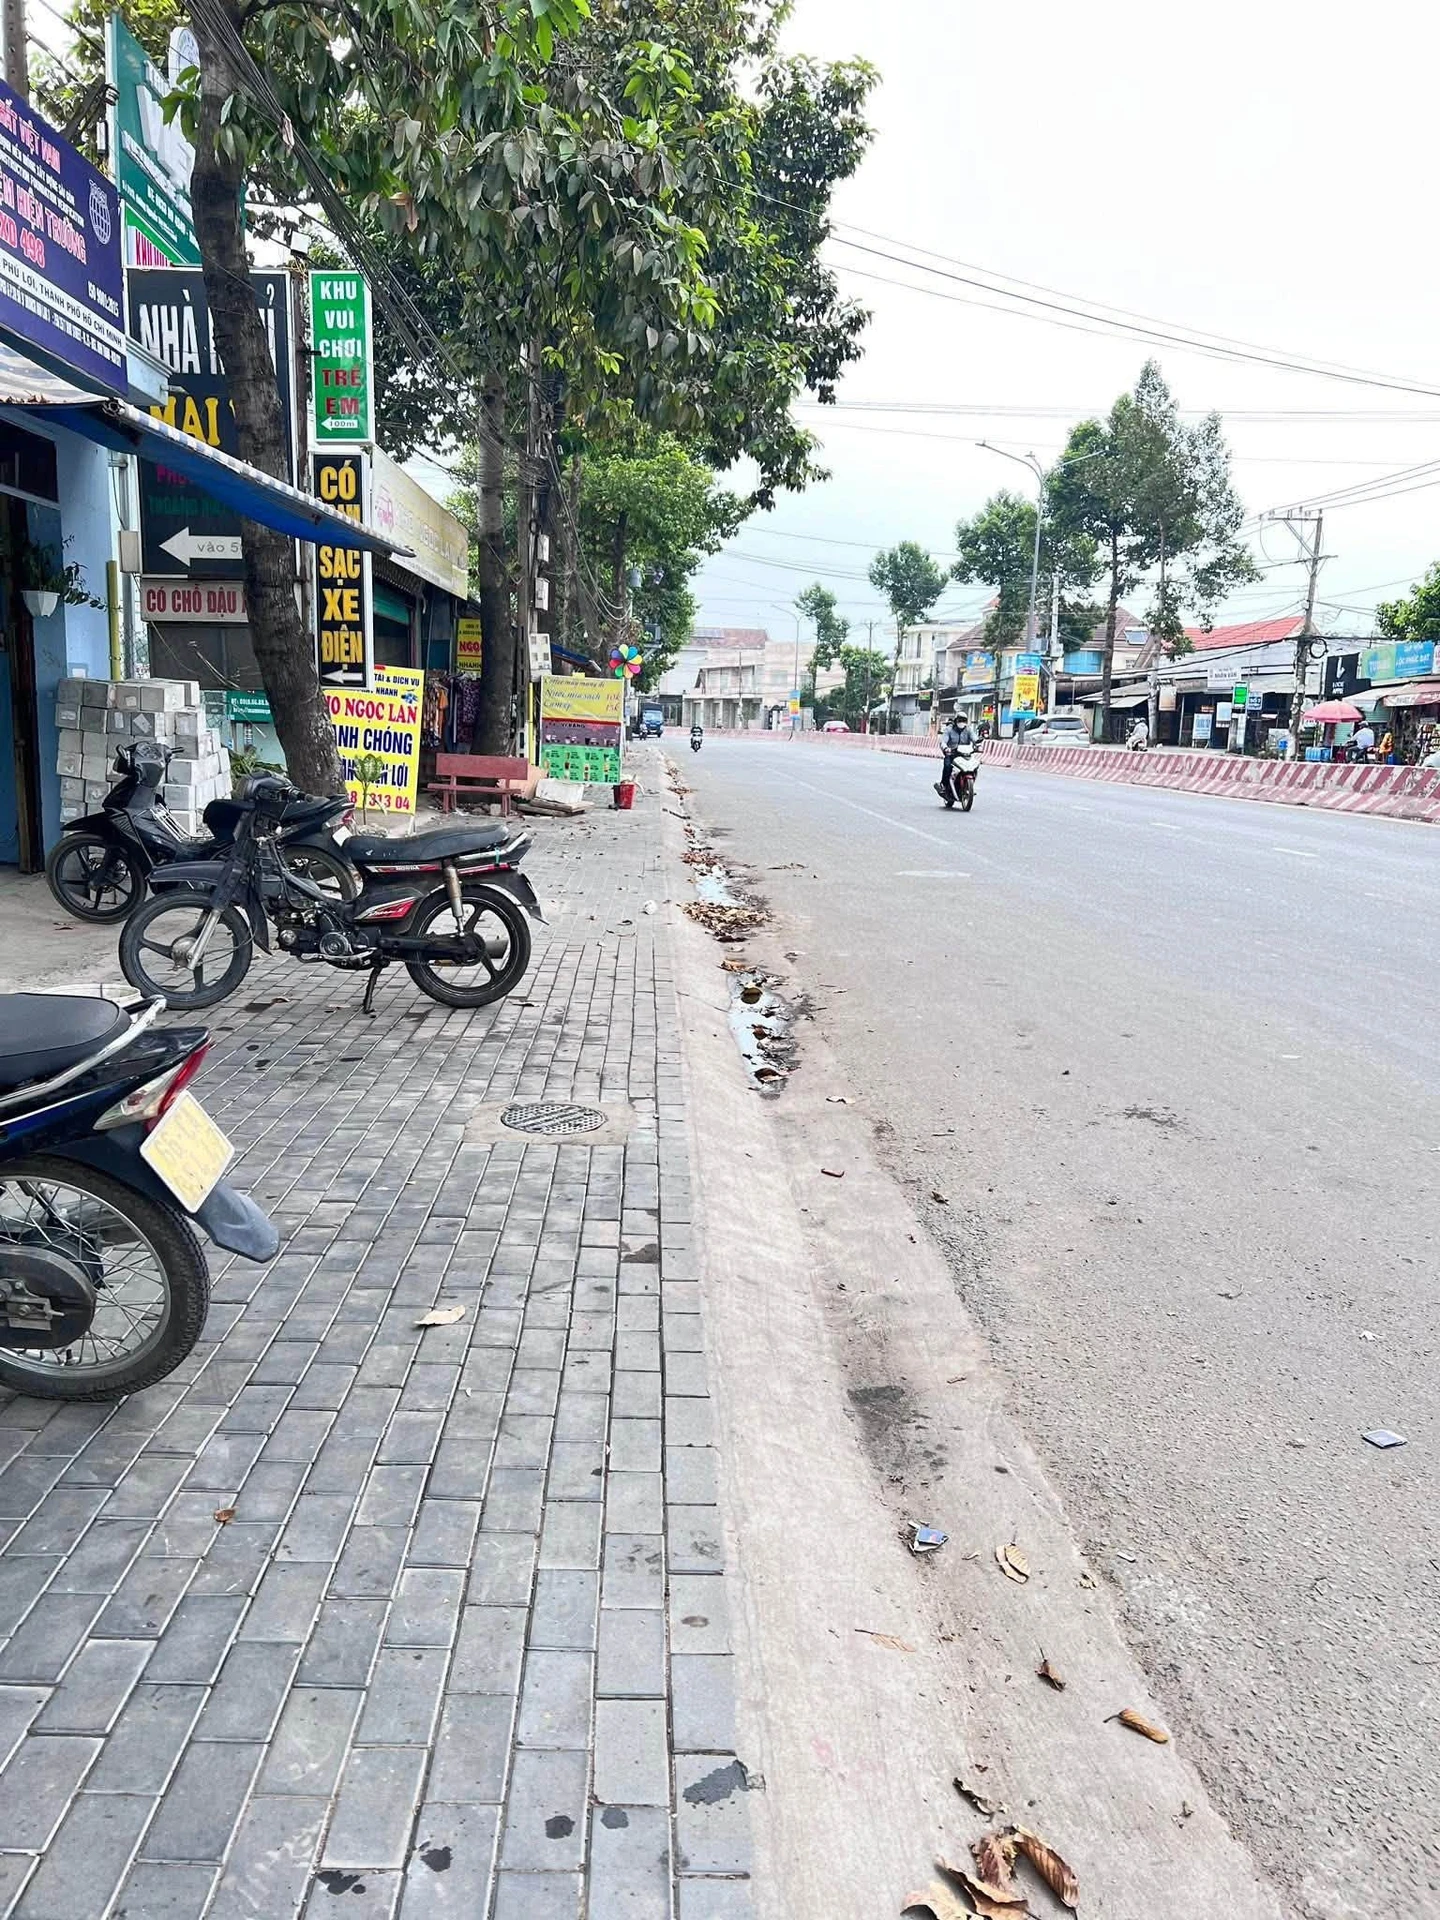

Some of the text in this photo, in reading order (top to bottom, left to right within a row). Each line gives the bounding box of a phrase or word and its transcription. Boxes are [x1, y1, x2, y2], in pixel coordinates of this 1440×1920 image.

[20, 226, 45, 269] 498
[320, 280, 357, 300] KHU
[139, 289, 201, 374] NHÀ
[324, 309, 355, 329] VUI
[319, 338, 362, 358] CHƠI
[326, 397, 360, 415] EM
[320, 460, 356, 501] CÓ
[198, 541, 225, 553] vào
[319, 545, 361, 586] SẠC
[146, 586, 167, 613] CÓ
[322, 588, 360, 622] XE
[321, 624, 363, 671] ĐIỆN
[376, 687, 398, 697] NHANH
[345, 699, 385, 723] NGỌC
[388, 703, 418, 724] LAN
[363, 726, 413, 755] CHÓNG
[391, 762, 408, 791] LỢI
[395, 795, 410, 810] 04
